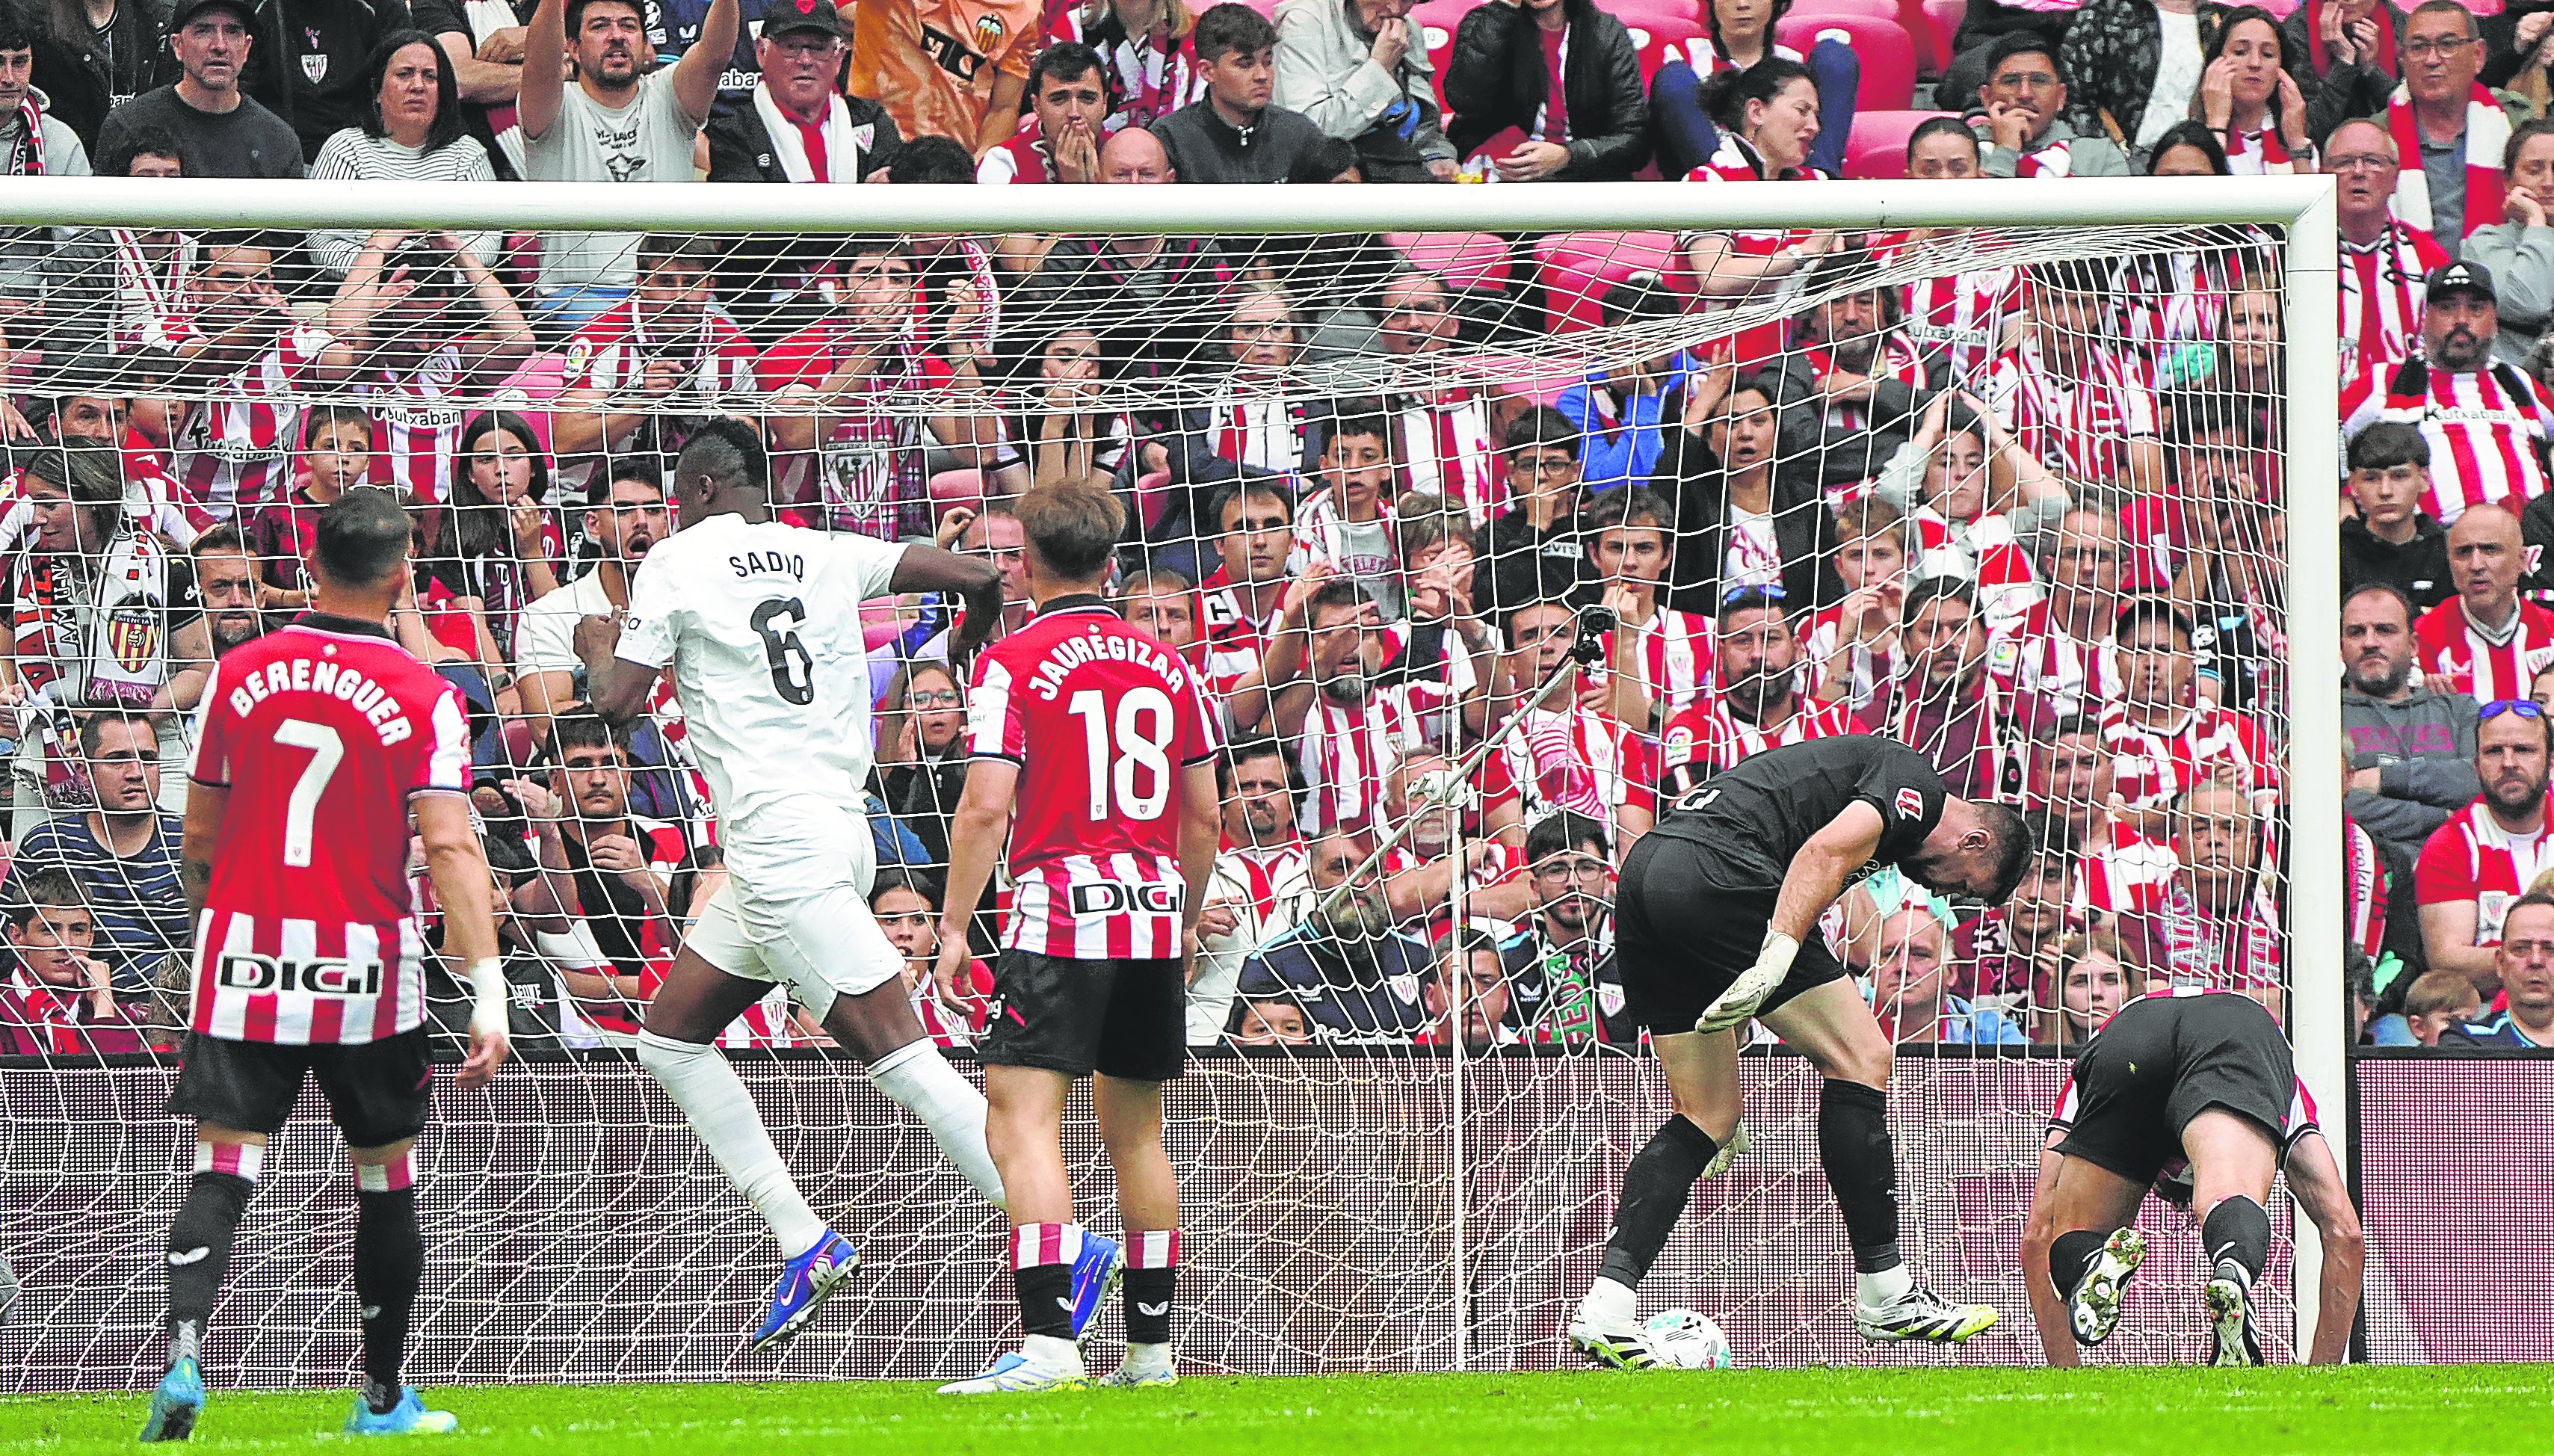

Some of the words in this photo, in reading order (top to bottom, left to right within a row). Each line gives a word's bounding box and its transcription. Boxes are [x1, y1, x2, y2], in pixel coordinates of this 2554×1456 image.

[729, 551, 803, 583] SADIQ
[750, 596, 814, 706] 6
[1028, 635, 1185, 701] JAUREGIZAR
[229, 658, 412, 747] BERENGUER
[1068, 686, 1175, 821] 18
[273, 718, 345, 867] 7
[1072, 883, 1185, 914] DIGI
[220, 954, 380, 995] DIGI
